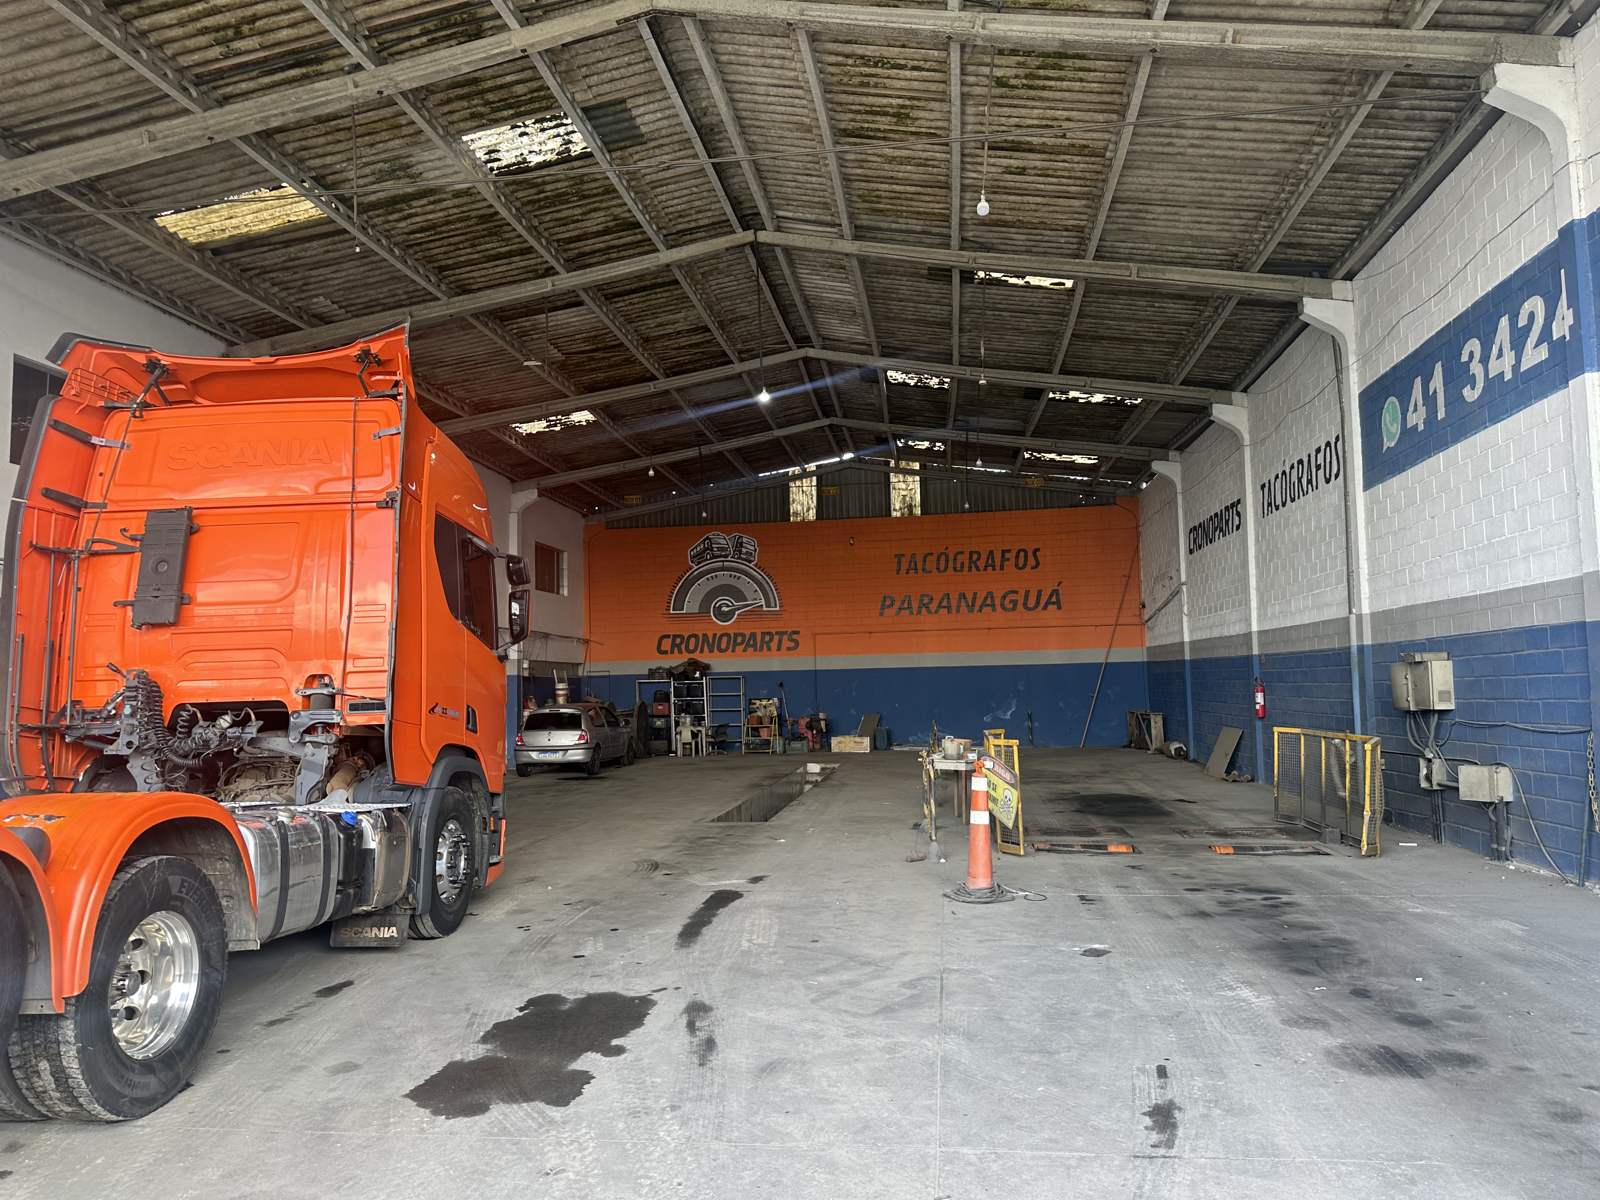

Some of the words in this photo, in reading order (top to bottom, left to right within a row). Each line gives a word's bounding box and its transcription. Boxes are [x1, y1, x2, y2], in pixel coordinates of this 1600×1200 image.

[1406, 360, 1446, 432] 41
[1460, 268, 1574, 402] 3424
[167, 438, 333, 471] SCANIA
[1260, 433, 1341, 519] TACÓGRAFOS
[1188, 498, 1242, 555] CRONOPARTS
[894, 546, 1041, 576] TACÓGRAFOS
[879, 581, 1063, 617] PARANAGUÁ
[656, 630, 801, 655] CRONOPARTS
[340, 926, 399, 938] SCANIA
